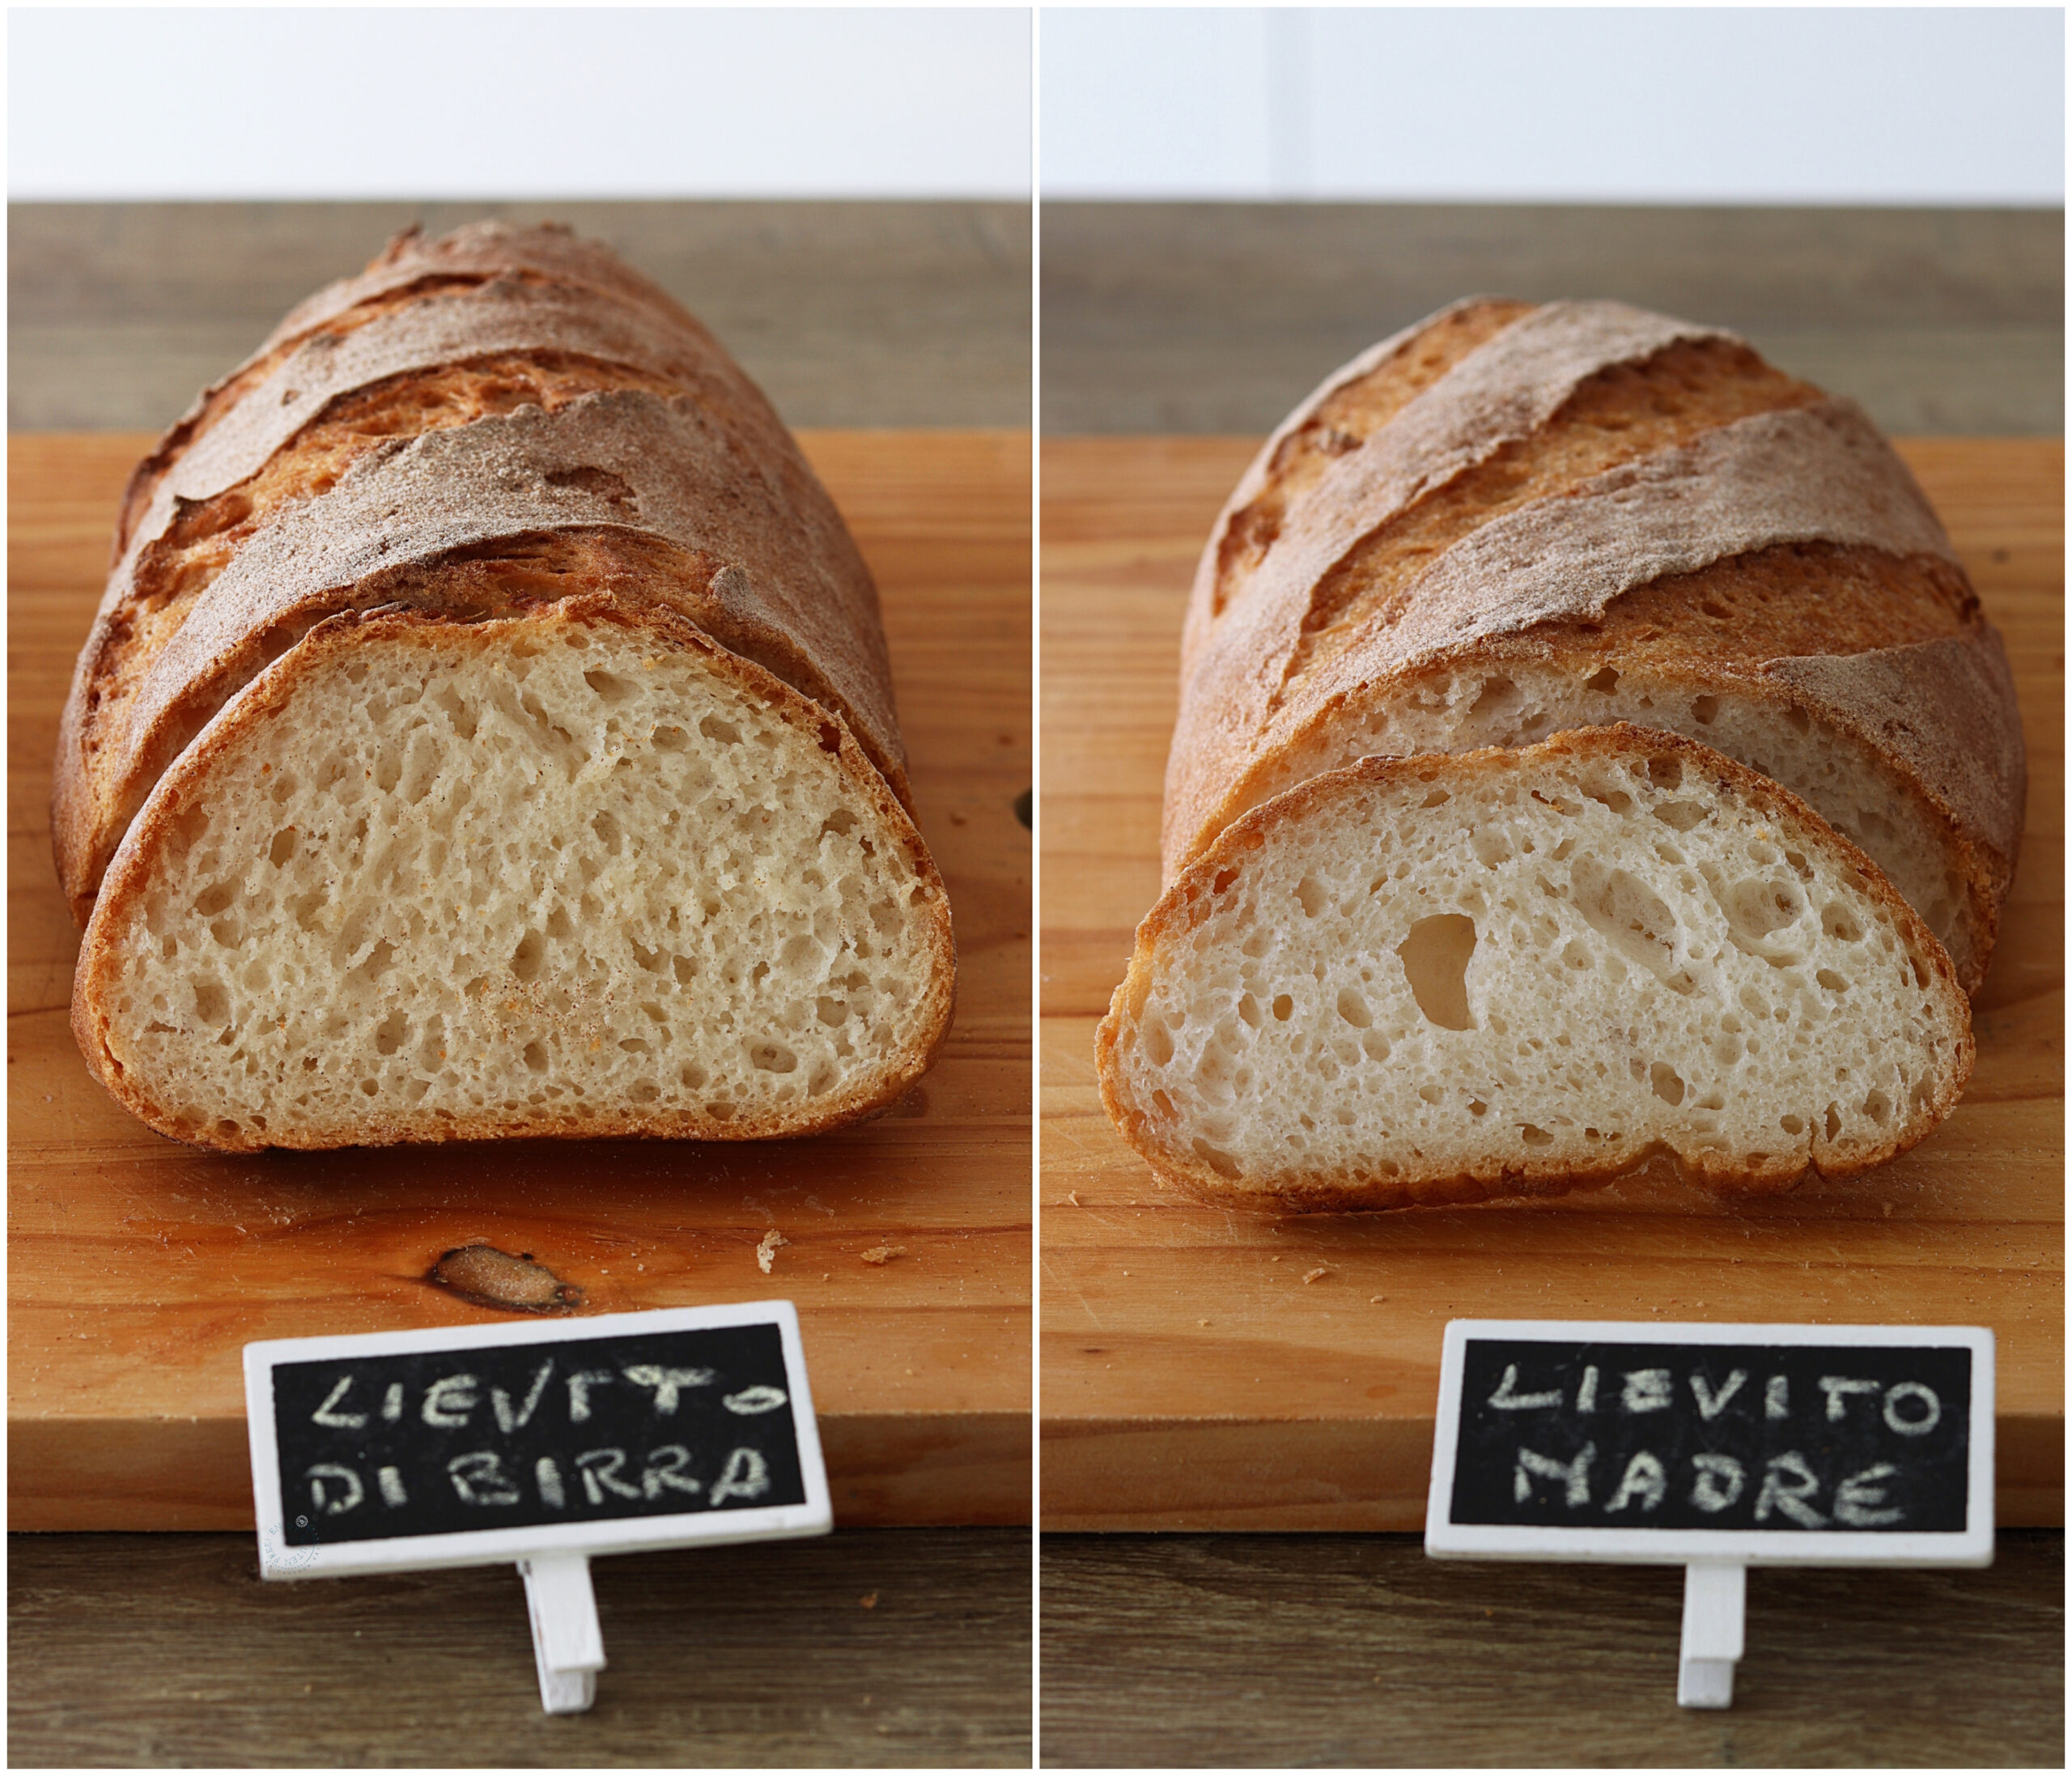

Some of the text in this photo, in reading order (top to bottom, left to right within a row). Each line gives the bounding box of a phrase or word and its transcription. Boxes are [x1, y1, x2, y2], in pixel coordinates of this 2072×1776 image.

[312, 1357, 788, 1433] LIEVITO
[1488, 1364, 1941, 1436] LIEVITO
[306, 1446, 770, 1515] DI BIRRA
[1514, 1441, 1905, 1527] MADRE
